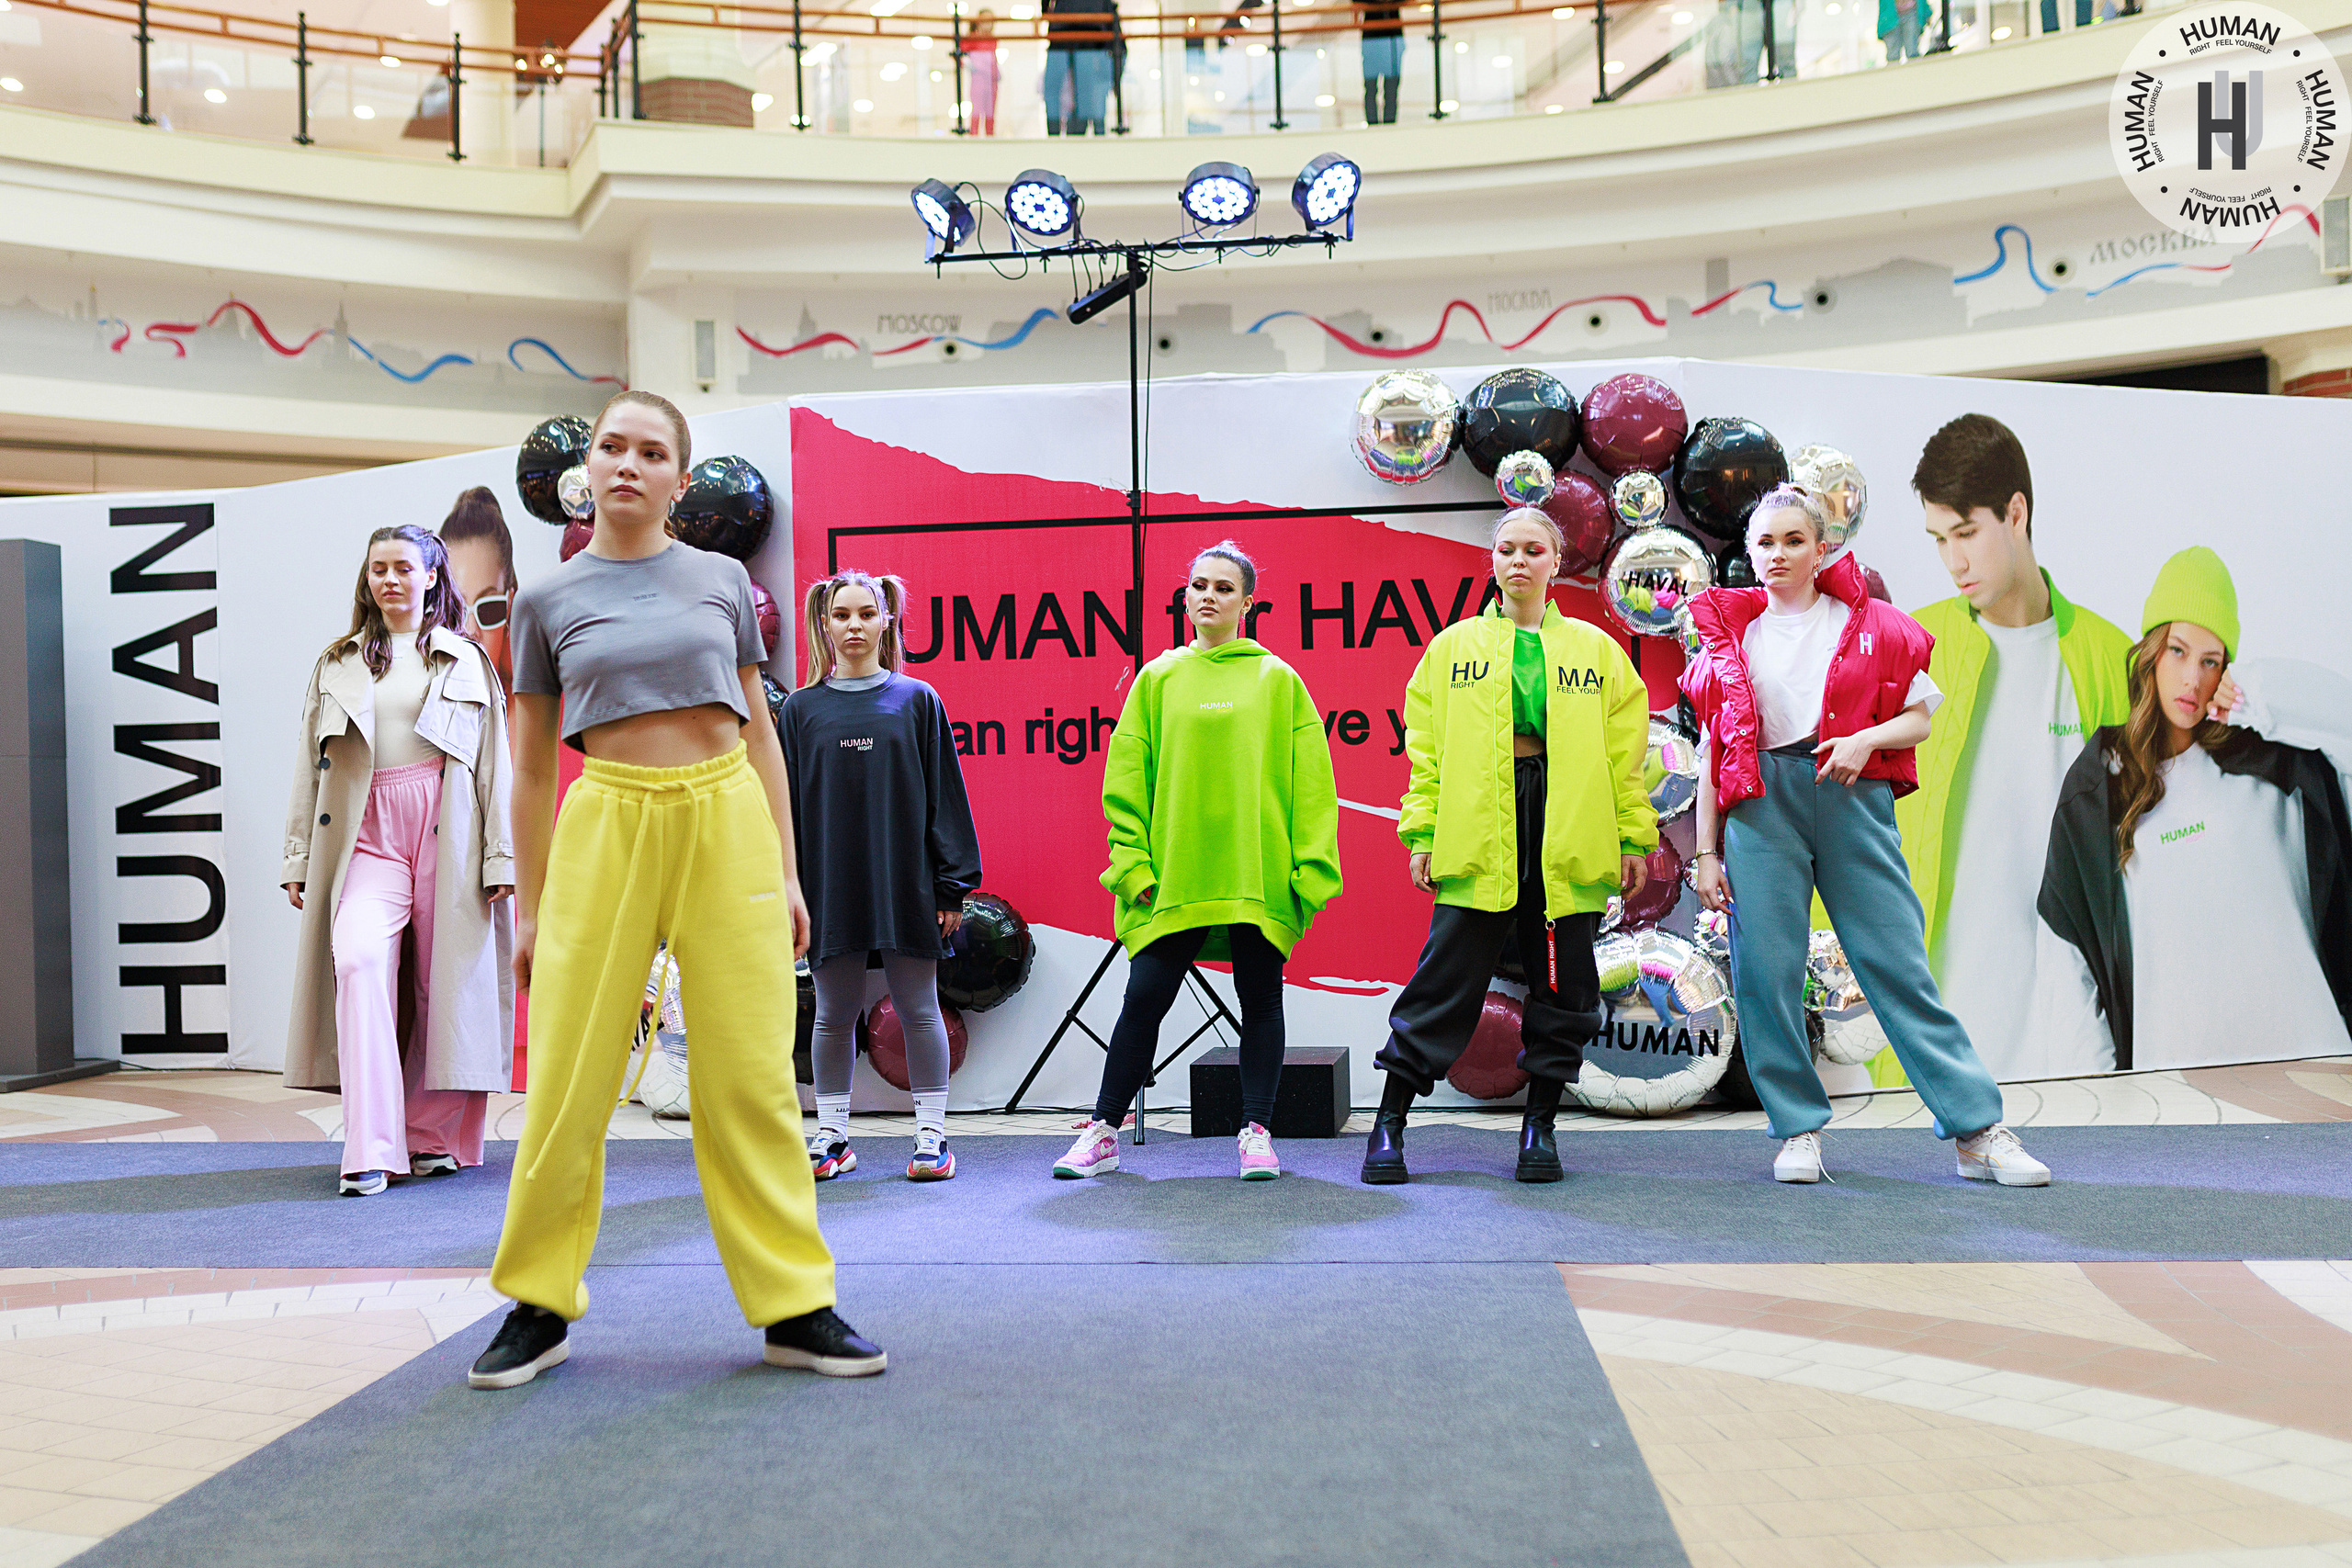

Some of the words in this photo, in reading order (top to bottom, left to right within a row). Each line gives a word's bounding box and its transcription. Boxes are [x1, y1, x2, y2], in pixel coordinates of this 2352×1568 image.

[877, 313, 962, 333] MOSCOW
[1627, 571, 1689, 596] HAVAL
[898, 589, 1136, 664] UMAN
[1165, 586, 1273, 650] fr
[1452, 660, 1489, 682] HU
[1556, 686, 1576, 694] FEEL
[1579, 687, 1601, 695] YOUR
[1200, 701, 1233, 709] HUMAN
[840, 738, 874, 748] HUMAN
[1025, 706, 1118, 765] righ
[109, 502, 229, 1055] HUMAN
[2160, 820, 2205, 844] HUMAN
[1591, 1021, 1719, 1056] HUMAN
